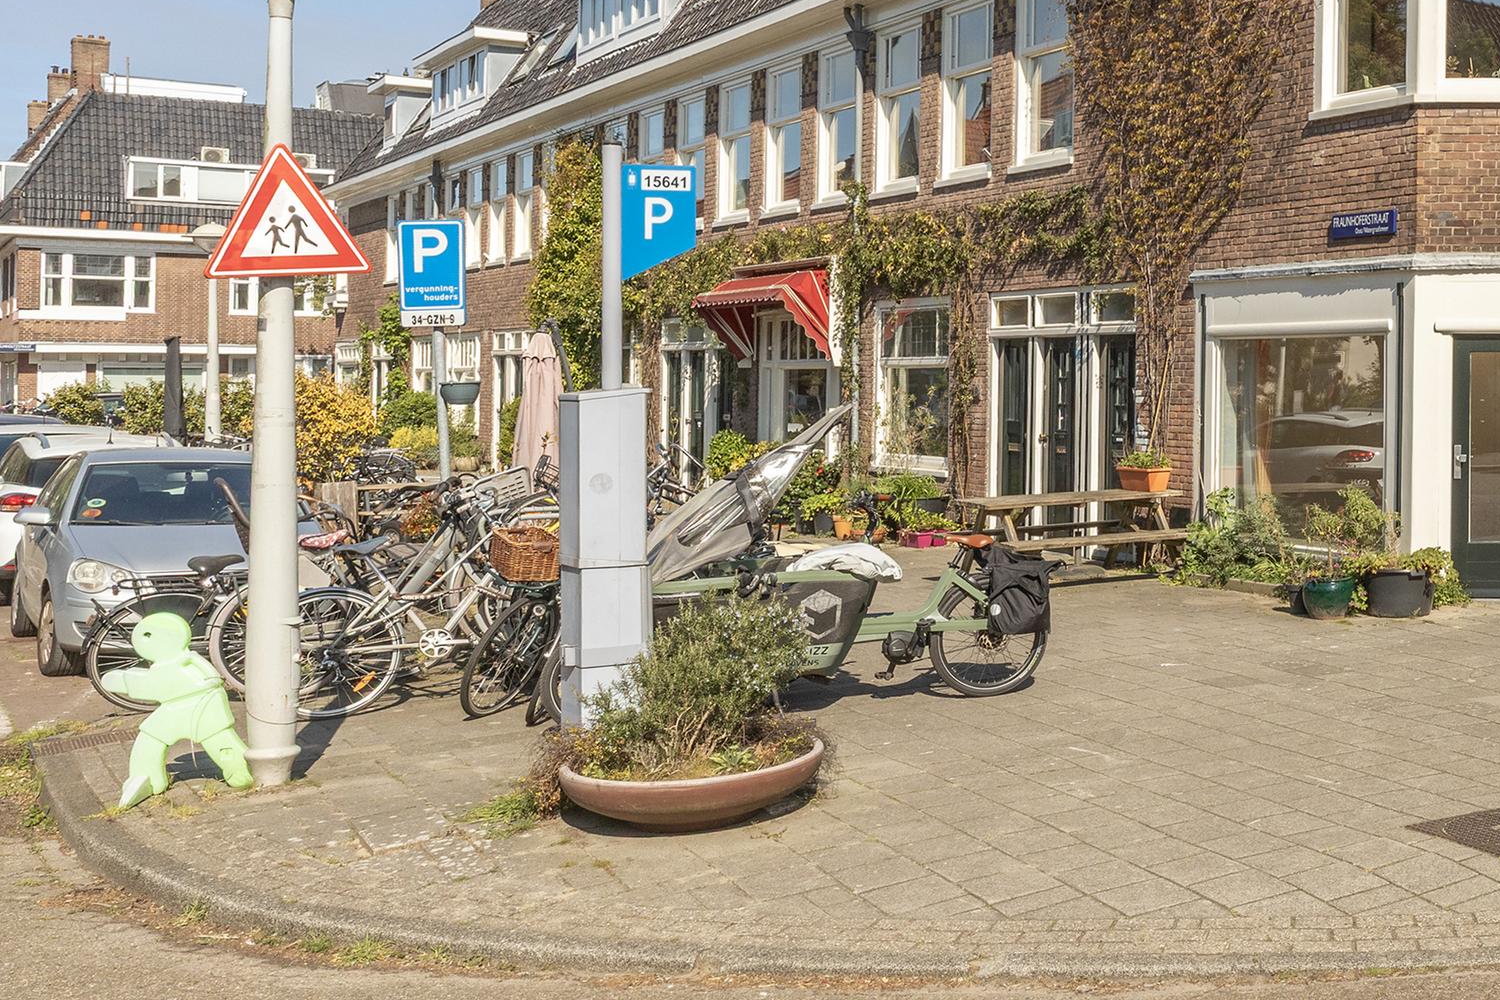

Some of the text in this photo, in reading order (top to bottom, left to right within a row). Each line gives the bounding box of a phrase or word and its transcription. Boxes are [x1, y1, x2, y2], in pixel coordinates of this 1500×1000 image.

[644, 175, 687, 188] 15641
[644, 196, 673, 240] P
[1333, 212, 1389, 228] FRAUNHOFERSTRAAT
[413, 228, 448, 273] P
[405, 285, 458, 295] vergunning-
[424, 293, 458, 301] houders
